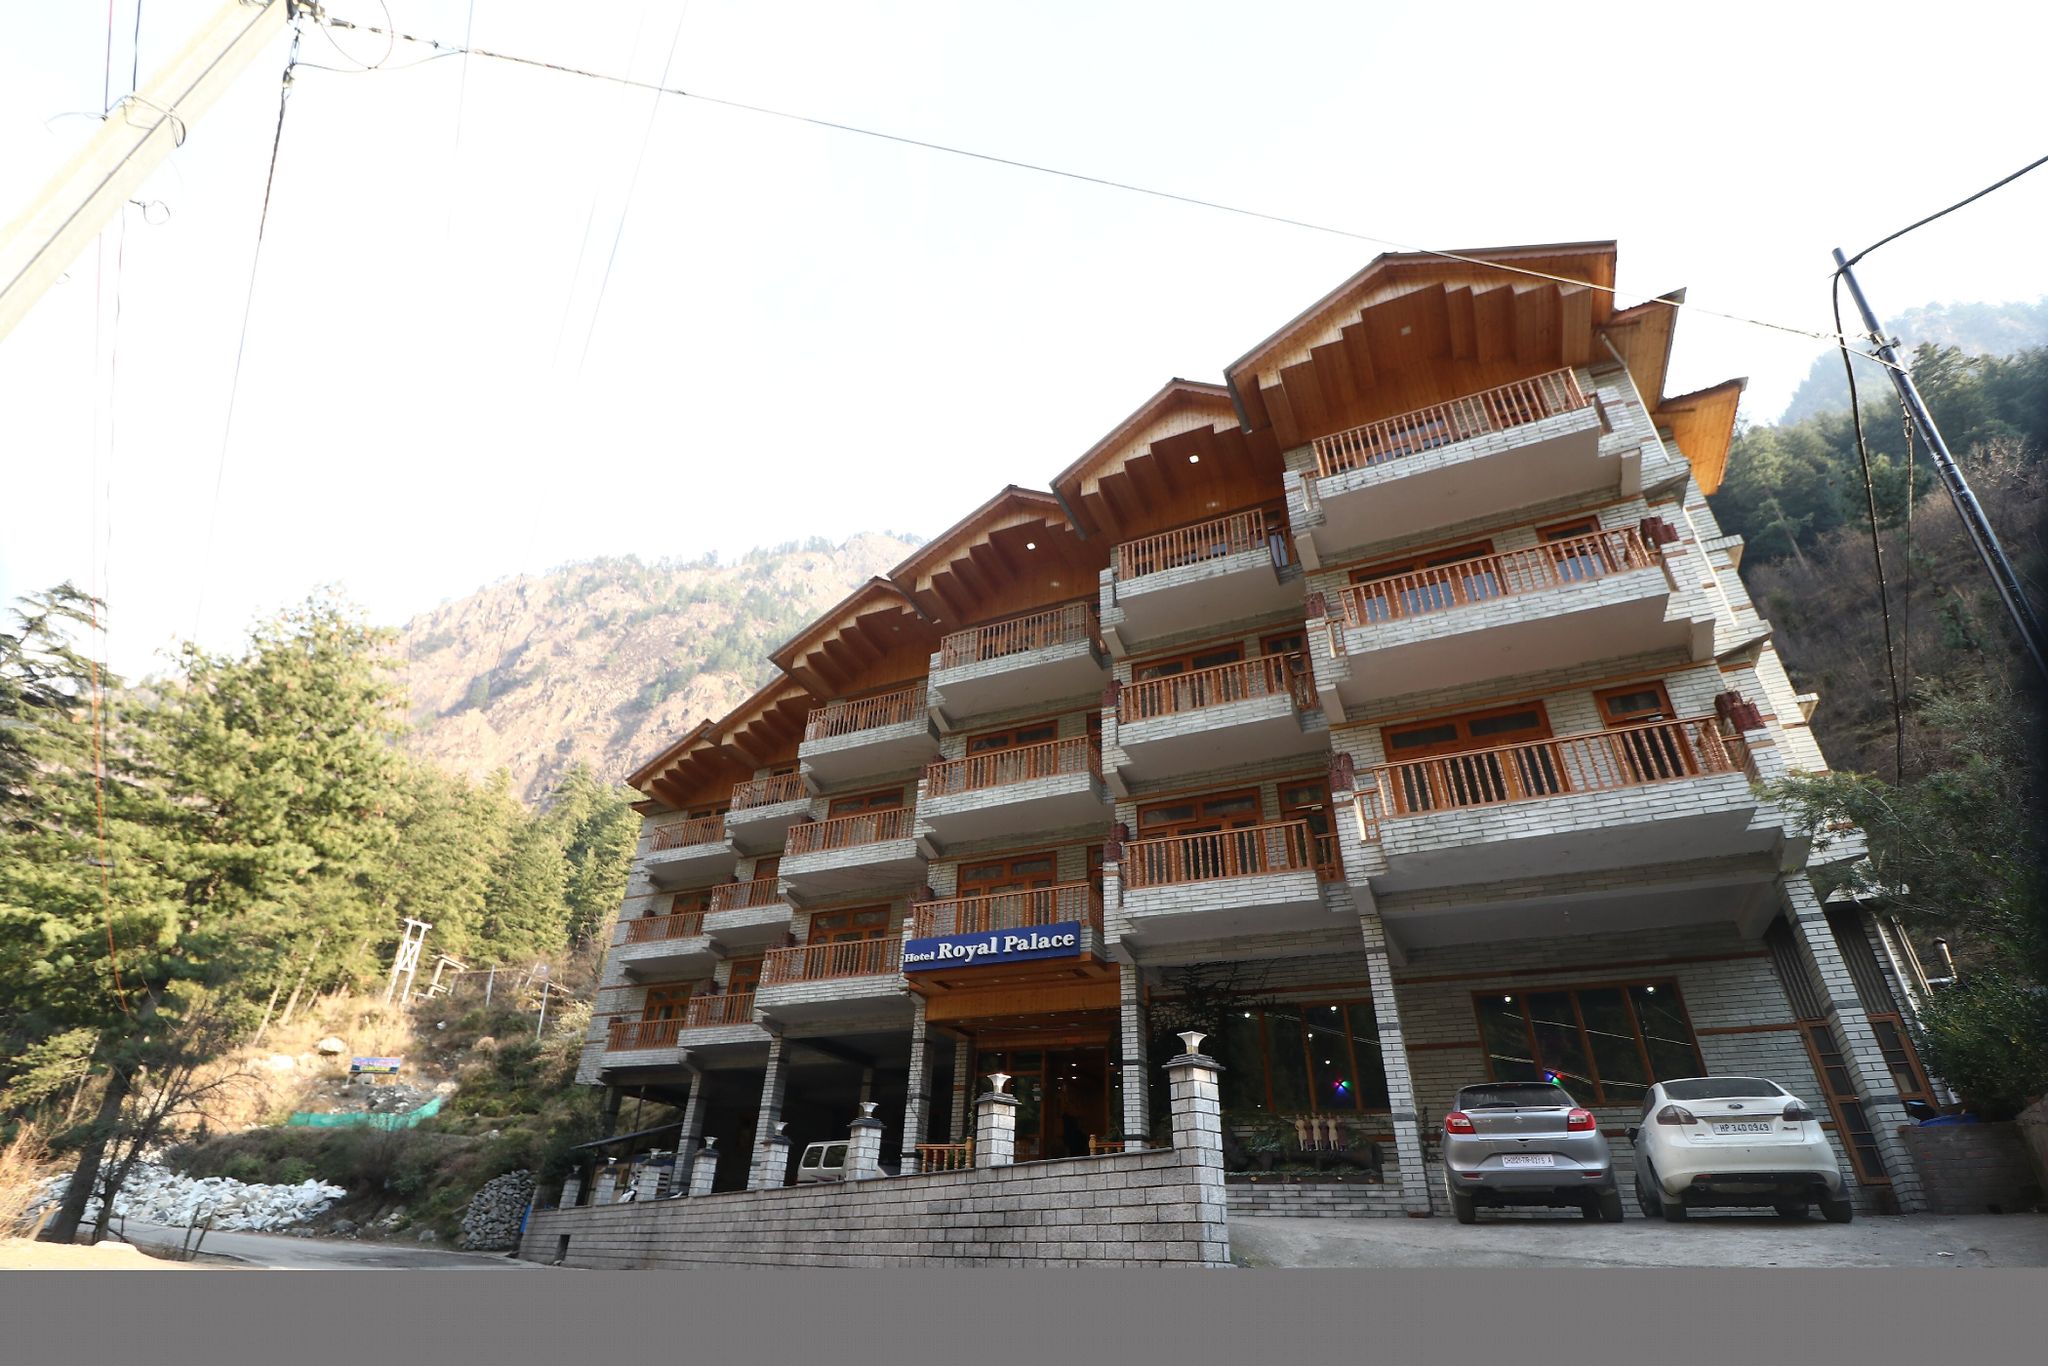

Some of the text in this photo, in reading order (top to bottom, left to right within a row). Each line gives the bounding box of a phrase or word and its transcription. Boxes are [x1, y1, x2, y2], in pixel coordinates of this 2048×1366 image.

[903, 932, 1076, 963] Hotel Royal Palace
[1719, 1123, 1730, 1132] HP
